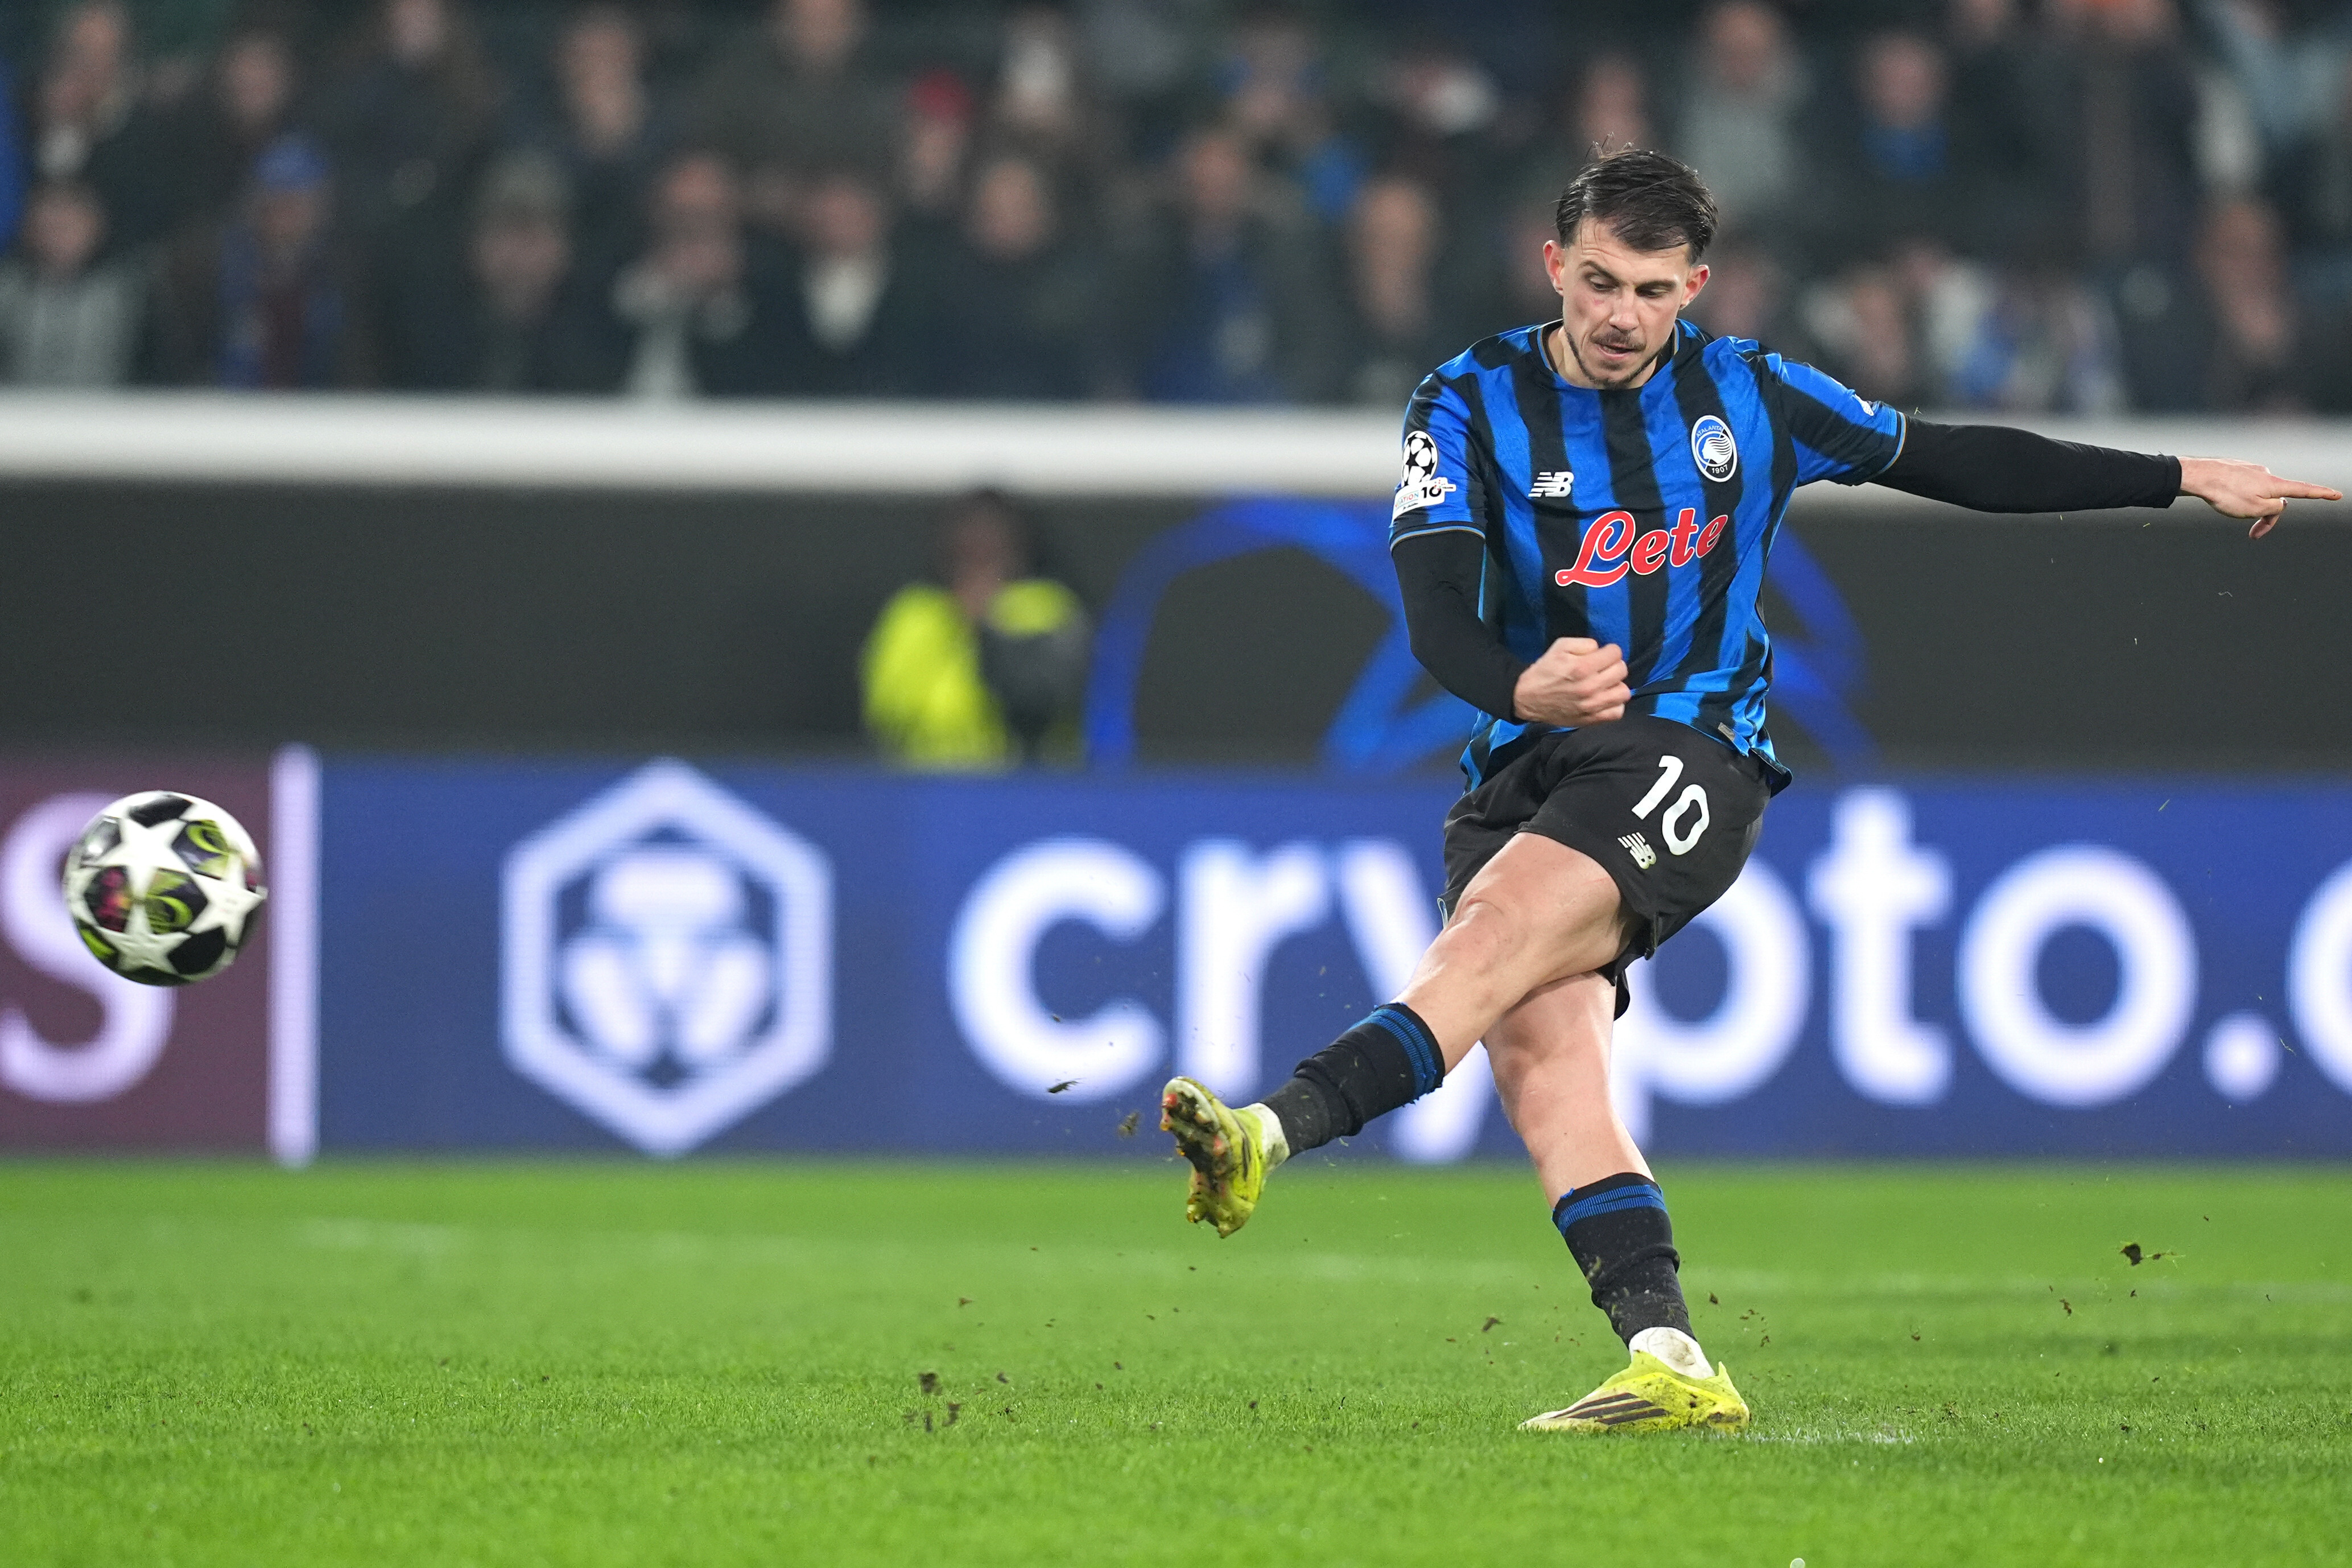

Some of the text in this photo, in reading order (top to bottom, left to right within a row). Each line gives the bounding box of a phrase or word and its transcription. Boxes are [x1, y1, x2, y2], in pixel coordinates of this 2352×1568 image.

[1696, 425, 1722, 438] ATALANTA
[1711, 464, 1728, 474] 1907
[1421, 486, 1442, 498] 10
[1528, 471, 1574, 497] NB
[1555, 507, 1728, 588] Lete
[1631, 755, 1710, 856] 10
